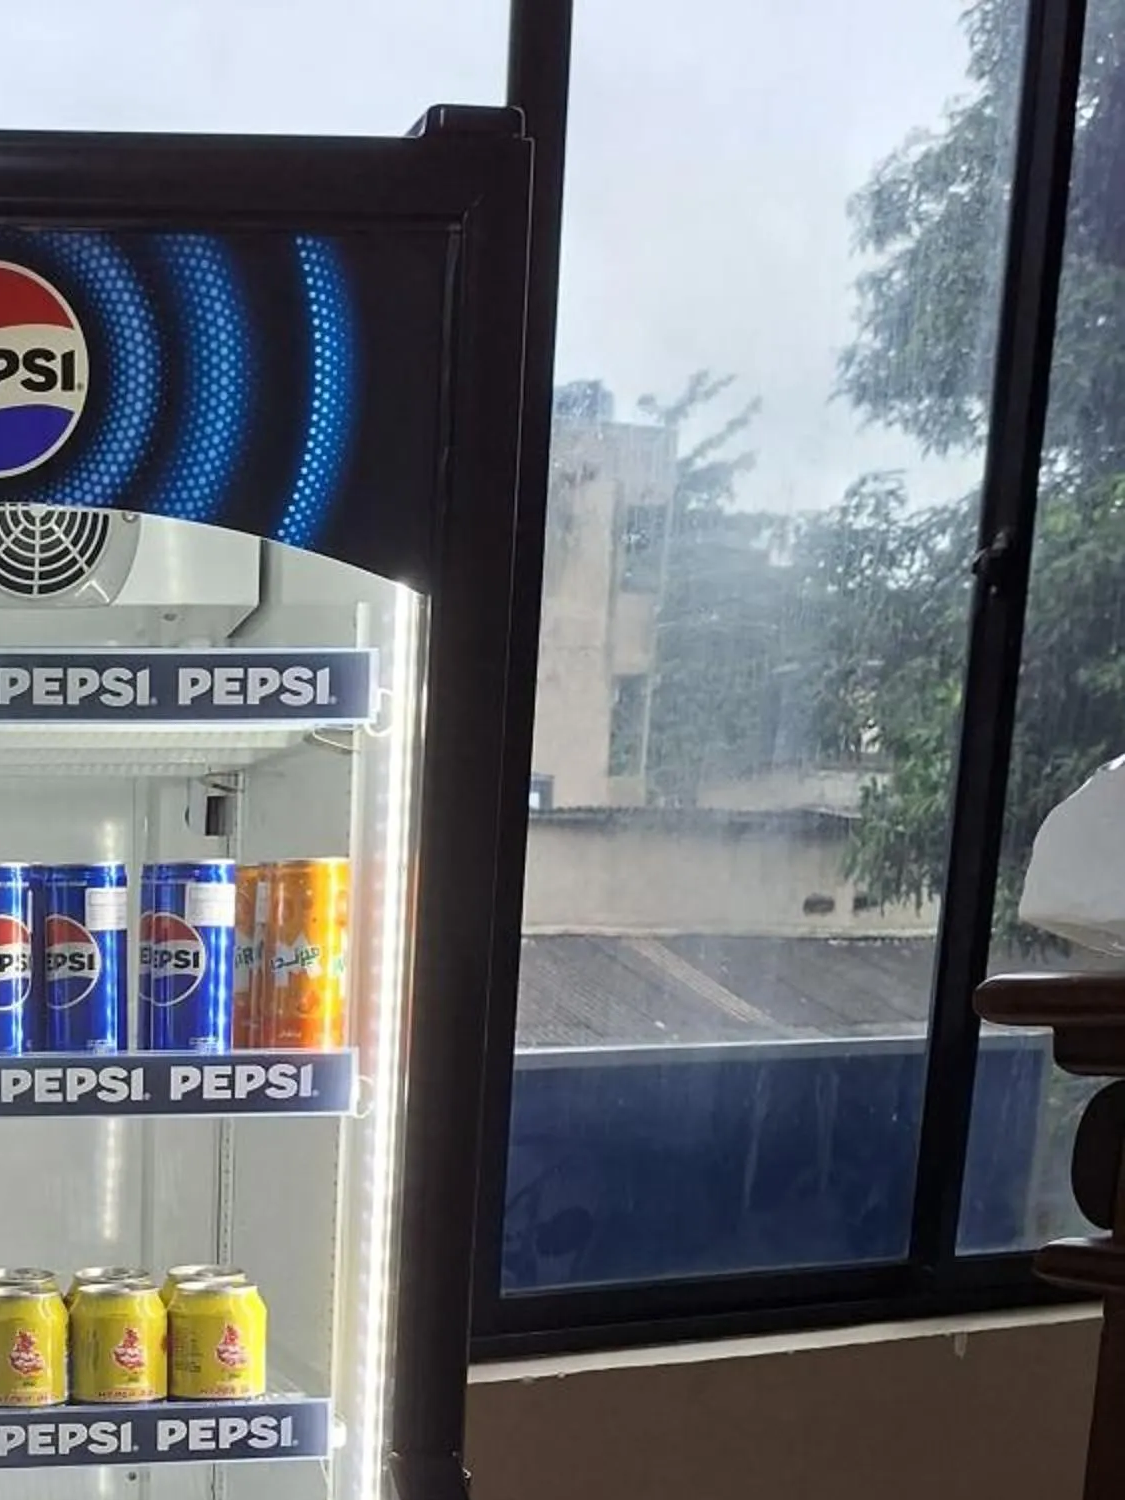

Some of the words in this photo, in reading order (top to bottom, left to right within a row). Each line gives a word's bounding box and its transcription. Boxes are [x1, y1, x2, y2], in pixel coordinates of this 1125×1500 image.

[179, 667, 332, 706] PEPSI
[1, 1067, 144, 1102] PEPSI
[171, 1064, 311, 1100] PEPSI
[157, 1416, 291, 1451] PEPSI
